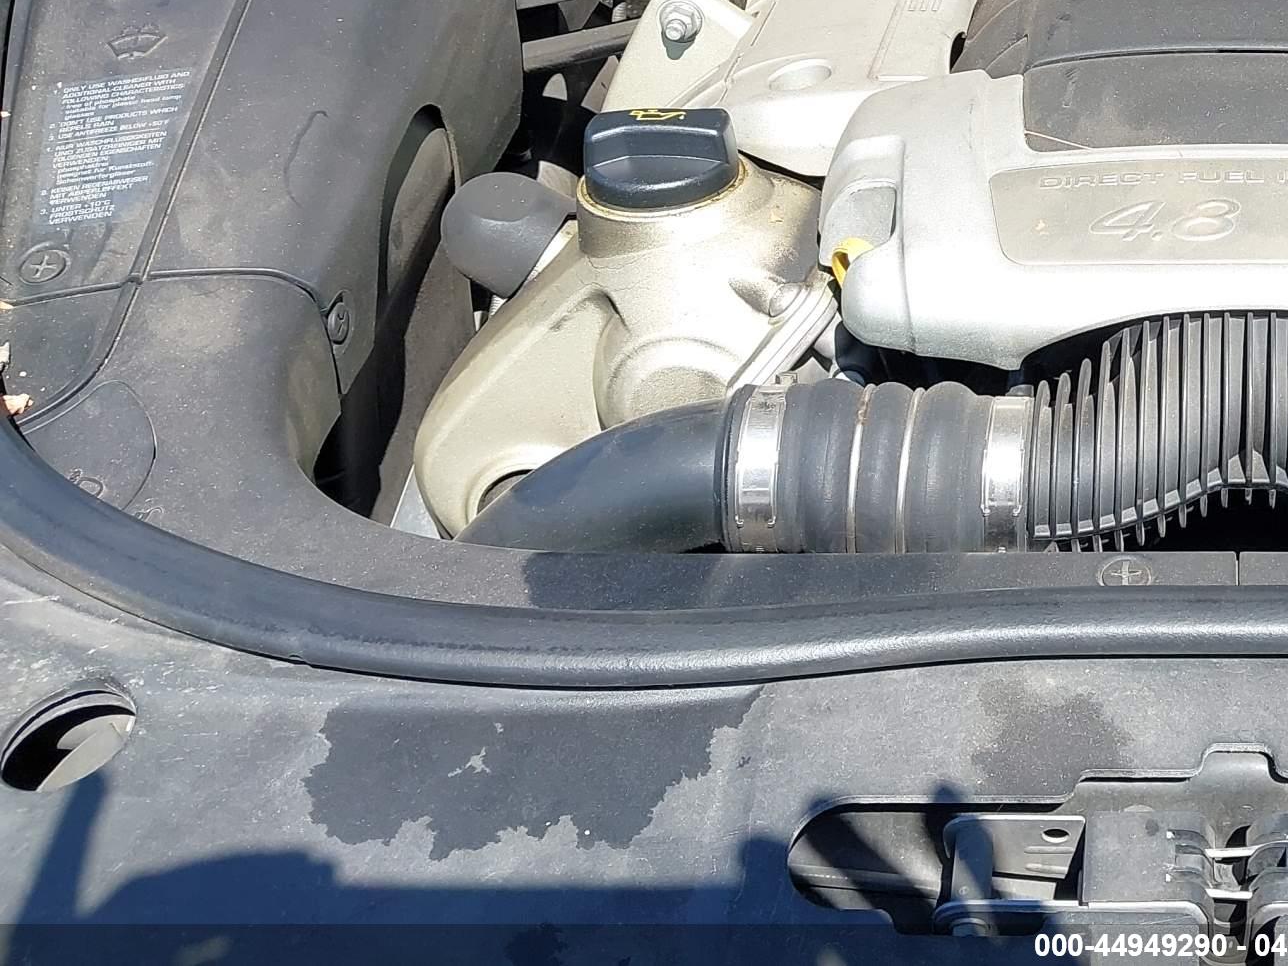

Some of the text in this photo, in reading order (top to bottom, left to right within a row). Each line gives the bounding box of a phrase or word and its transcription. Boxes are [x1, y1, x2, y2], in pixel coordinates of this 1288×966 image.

[1039, 171, 1164, 188] DIRECT
[1178, 169, 1267, 184] FUEL
[1089, 197, 1240, 242] 4.8
